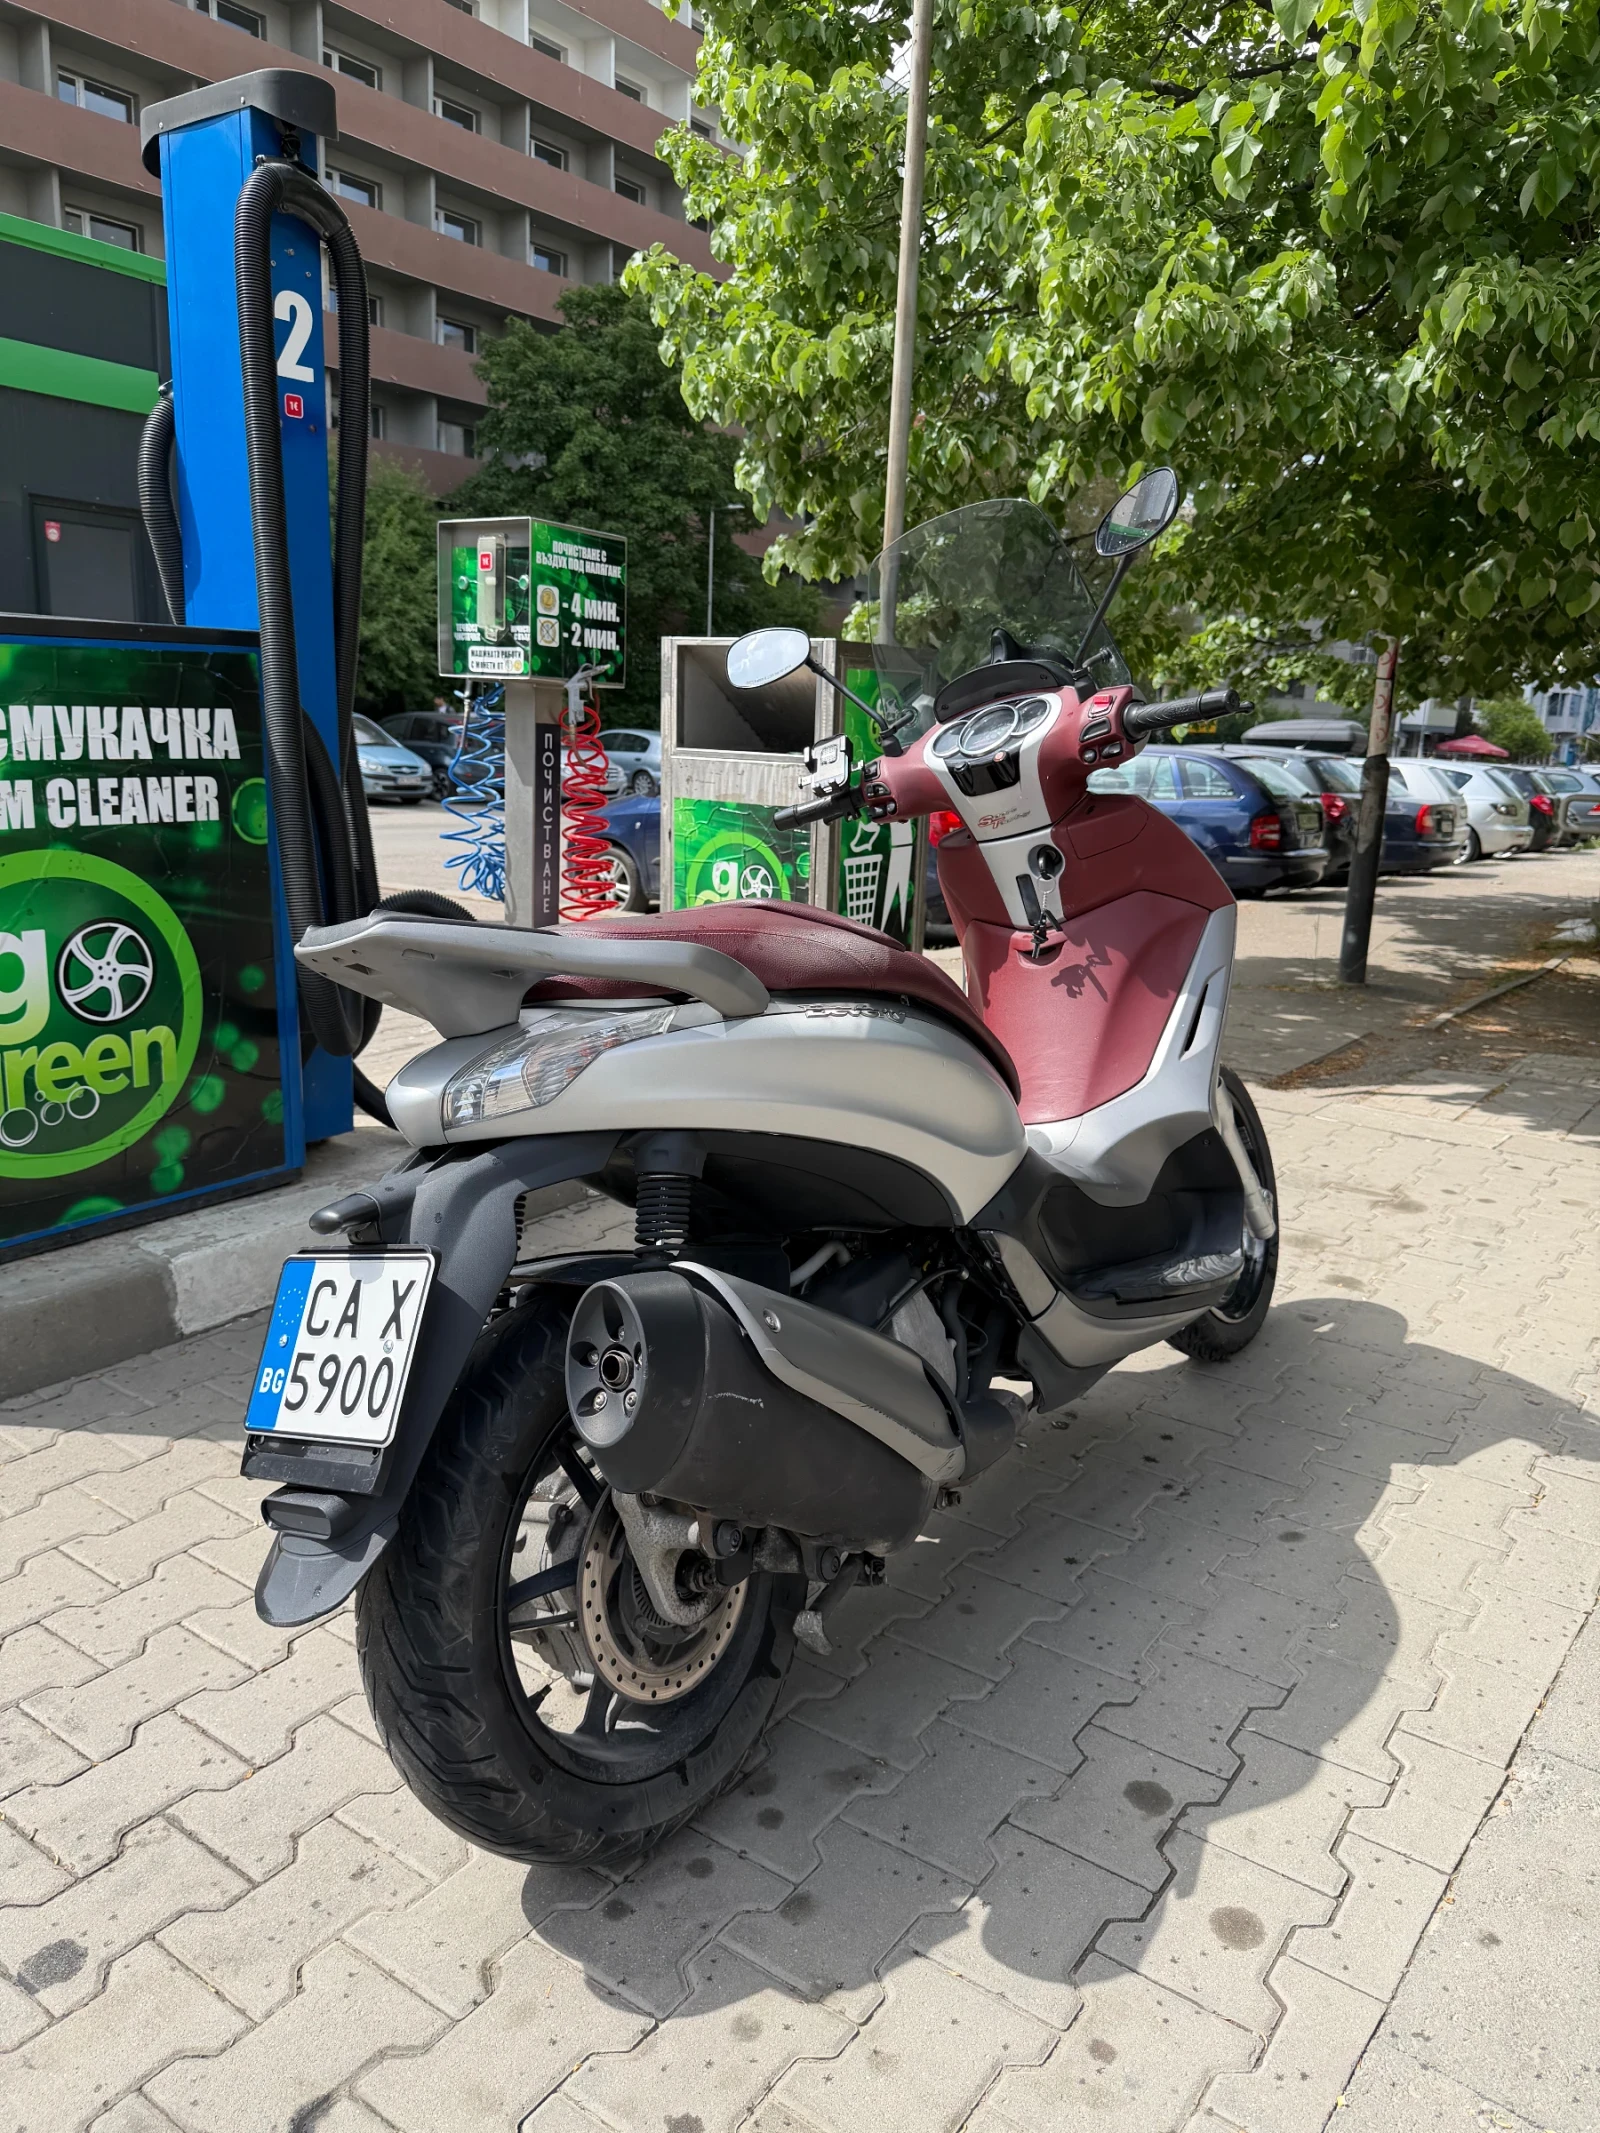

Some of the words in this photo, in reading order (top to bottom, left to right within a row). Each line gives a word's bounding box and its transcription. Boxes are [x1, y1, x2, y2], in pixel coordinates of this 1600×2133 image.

[274, 289, 315, 383] 2
[535, 551, 568, 569] ВЪЗДУХ
[568, 557, 585, 574] ПОД
[585, 560, 622, 579] НАЛЯГАНЕ
[552, 540, 601, 562] ПОЧИСТВАНЕ
[601, 549, 607, 563] С
[571, 592, 581, 618] 4
[584, 598, 620, 623] МИН.
[571, 622, 582, 647] 2
[584, 628, 620, 651] МИН.
[0, 704, 241, 763] МУКАЧКА
[46, 776, 220, 829] CLEANER
[542, 733, 555, 913] ПОЧИСТВАНЕ
[0, 1025, 178, 1116] reen
[306, 1279, 363, 1339] CA
[379, 1279, 417, 1340] X
[258, 1367, 286, 1394] BG
[284, 1352, 394, 1419] 5900
